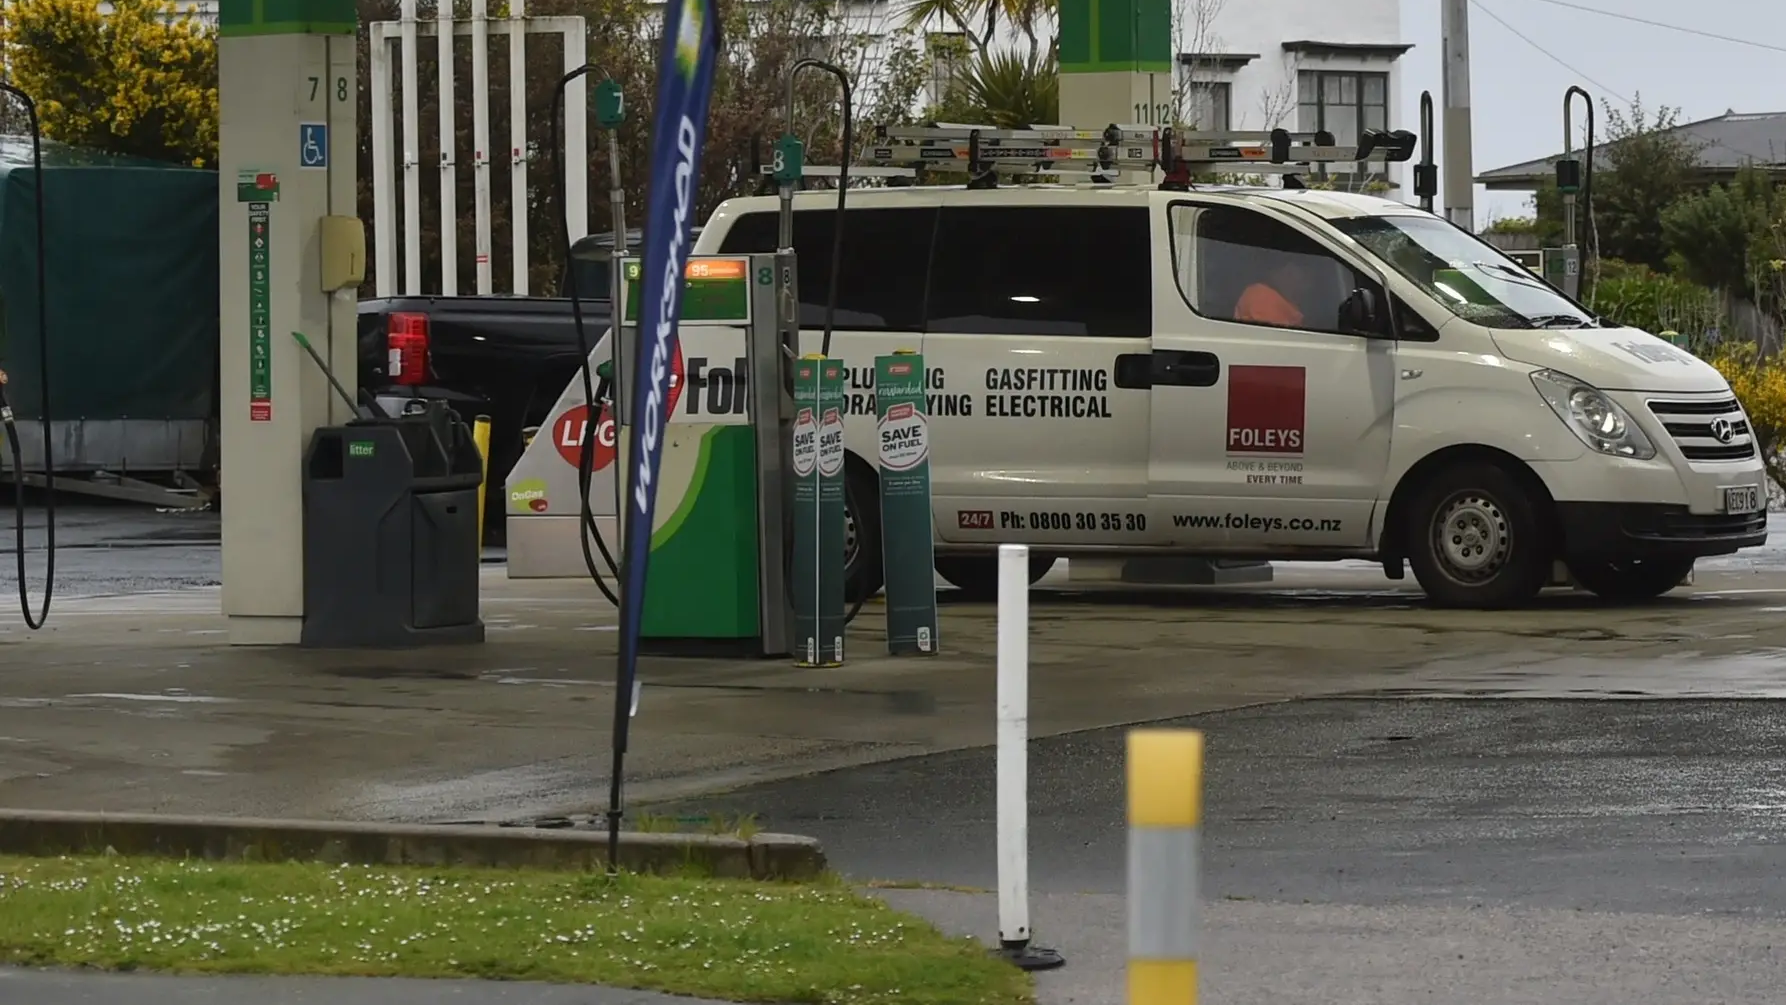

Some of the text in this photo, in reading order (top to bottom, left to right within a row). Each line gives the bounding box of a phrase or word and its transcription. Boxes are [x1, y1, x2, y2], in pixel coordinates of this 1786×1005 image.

[308, 77, 347, 101] 7 8
[613, 92, 623, 114] 7
[1134, 103, 1171, 125] 11 12
[773, 150, 784, 171] 8
[758, 267, 773, 285] 8
[986, 367, 1108, 391] GASFITTING
[986, 395, 1112, 418] ELECTRICAL
[795, 431, 815, 447] SAVE
[820, 431, 841, 448] SAVE
[882, 425, 922, 443] SAVE
[1229, 428, 1301, 448] FOLEYS
[882, 438, 923, 452] ON FUEL
[1246, 475, 1303, 485] EVERY TIME
[961, 513, 991, 525] 24/7
[1001, 511, 1146, 531] Ph: 0800 30 35 30
[1172, 512, 1341, 532] www.foleys.co.nz
